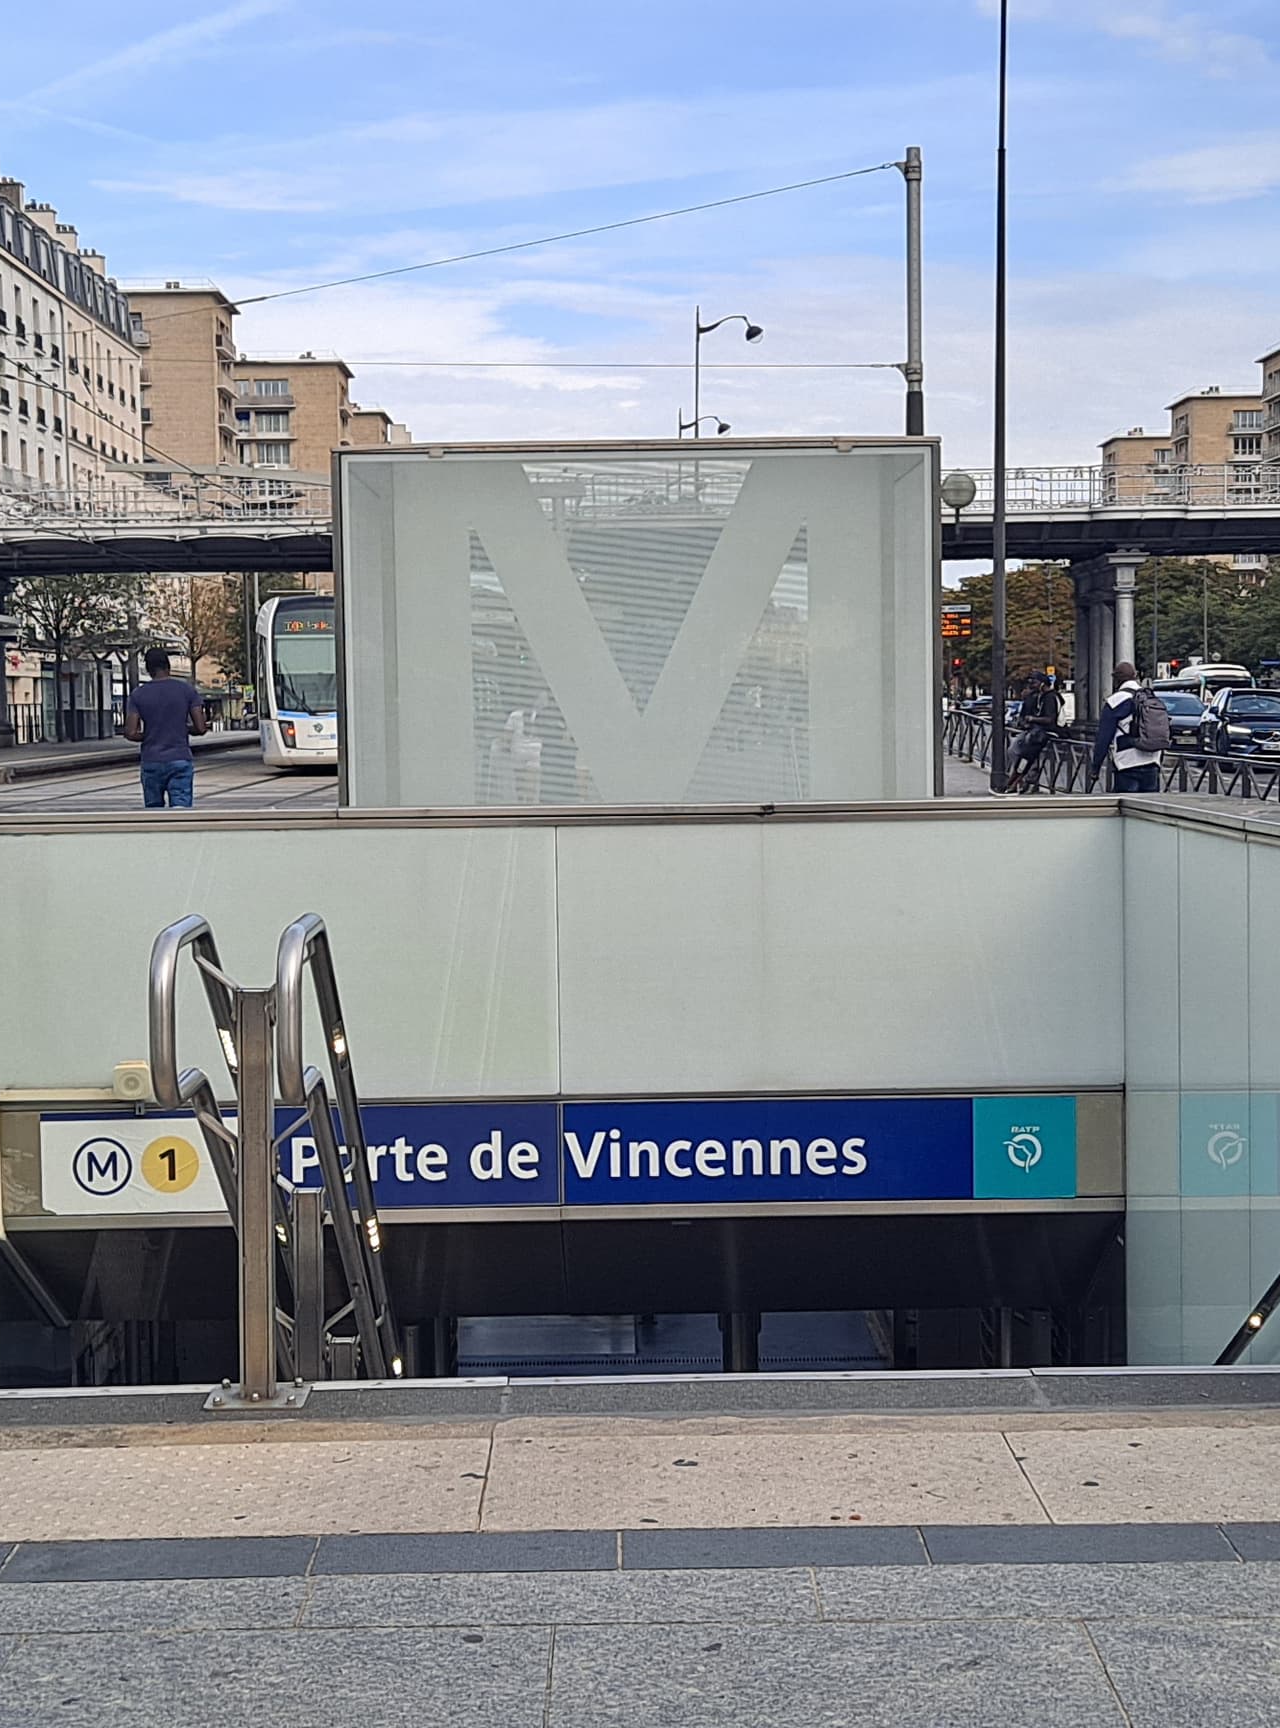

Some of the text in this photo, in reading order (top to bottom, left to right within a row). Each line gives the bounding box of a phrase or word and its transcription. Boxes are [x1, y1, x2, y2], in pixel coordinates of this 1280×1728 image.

[158, 1148, 177, 1181] 1
[290, 1128, 868, 1184] Prte de Vincennes
